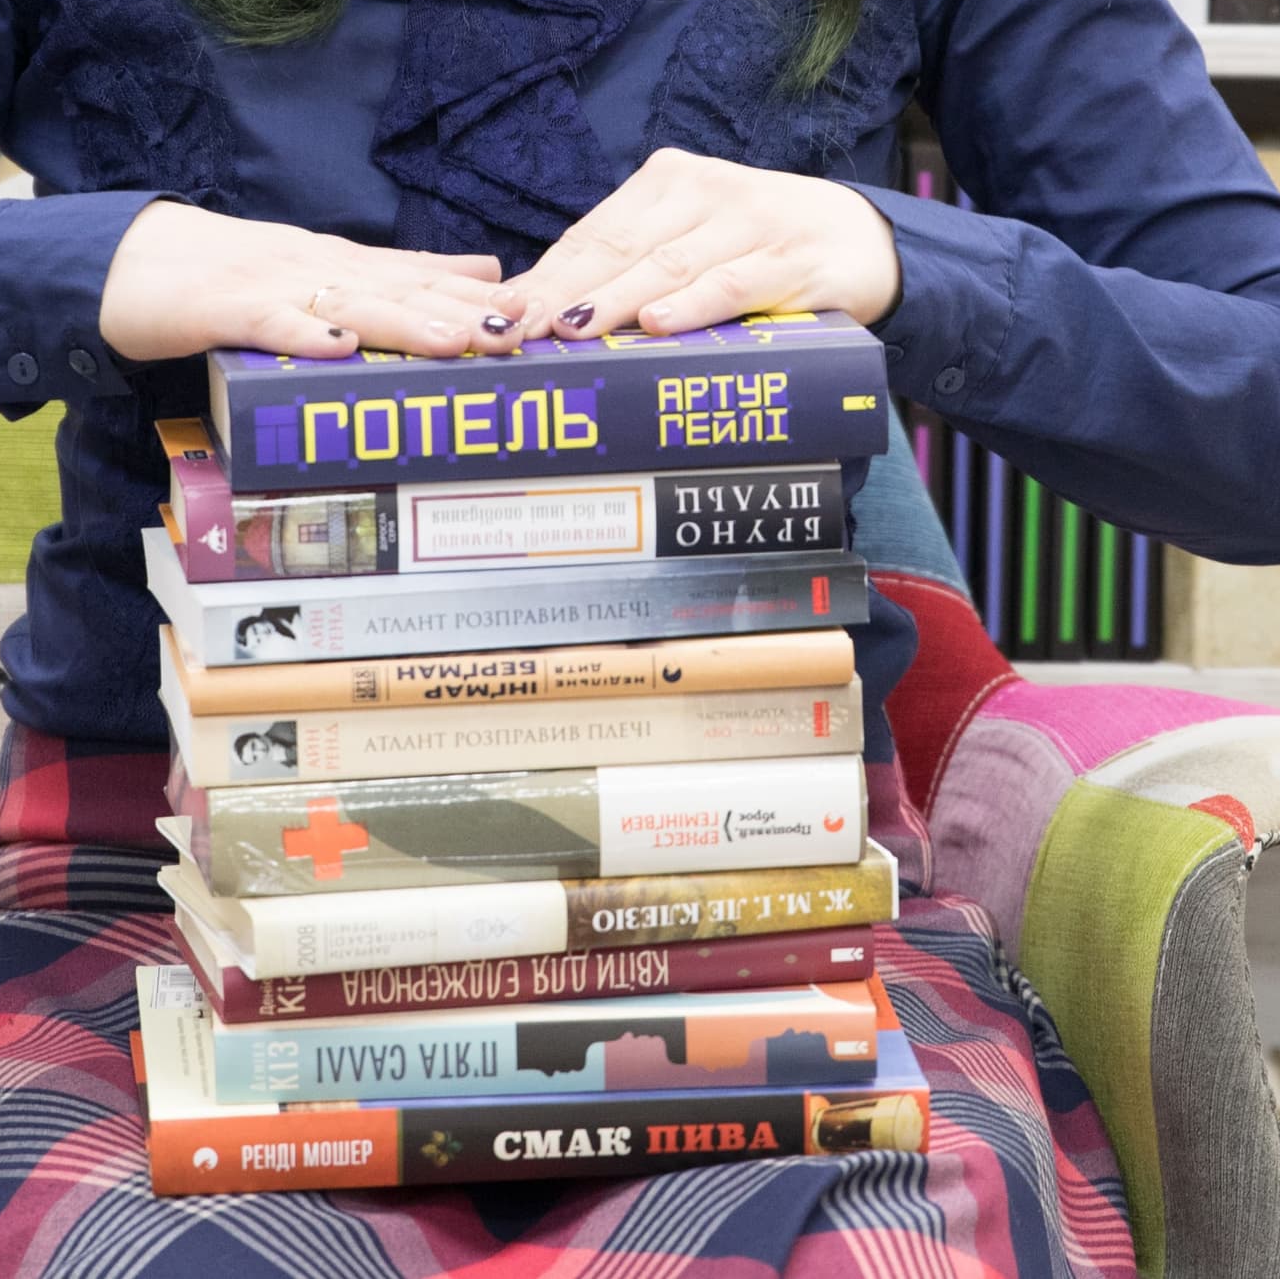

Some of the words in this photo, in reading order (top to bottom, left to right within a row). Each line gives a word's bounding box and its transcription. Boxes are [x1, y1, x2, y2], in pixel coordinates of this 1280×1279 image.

[657, 371, 789, 412] АРТУР
[303, 388, 599, 464] ГОТЕЛЬ
[658, 407, 789, 448] ГЕЙЛІ
[675, 481, 821, 514] ШУЛЬЦ
[676, 516, 821, 548] БРУНО
[365, 613, 448, 635] АТЛАНТ
[455, 605, 580, 630] РОЗПРАВИВ
[587, 600, 650, 621] ПЛЕЧІ
[396, 660, 537, 681] БЕРҐМАН
[424, 680, 537, 700] ІНҐМАР
[364, 732, 448, 754] АТЛАНТ
[454, 724, 580, 750] РОЗПРАВИВ
[588, 721, 651, 741] ПЛЕЧІ
[653, 831, 720, 848] ЕРНЕСТ
[592, 902, 700, 933] КЛЕЗІО
[707, 898, 748, 924] ЛЕ
[778, 895, 812, 916] М.
[818, 888, 854, 913] Ж.
[296, 924, 317, 967] 2008
[341, 959, 520, 1006] ЕЛДЖЕРНОНА
[532, 952, 591, 995] ДЛЯ
[269, 1040, 300, 1091] КІЗ
[316, 1044, 406, 1084] САЛЛІ
[418, 1041, 498, 1079] П'ЯТА
[241, 1144, 297, 1172] РЕНДІ
[303, 1139, 374, 1168] МОШЕР
[493, 1126, 632, 1161] СМАК
[646, 1121, 780, 1154] ПИВА
